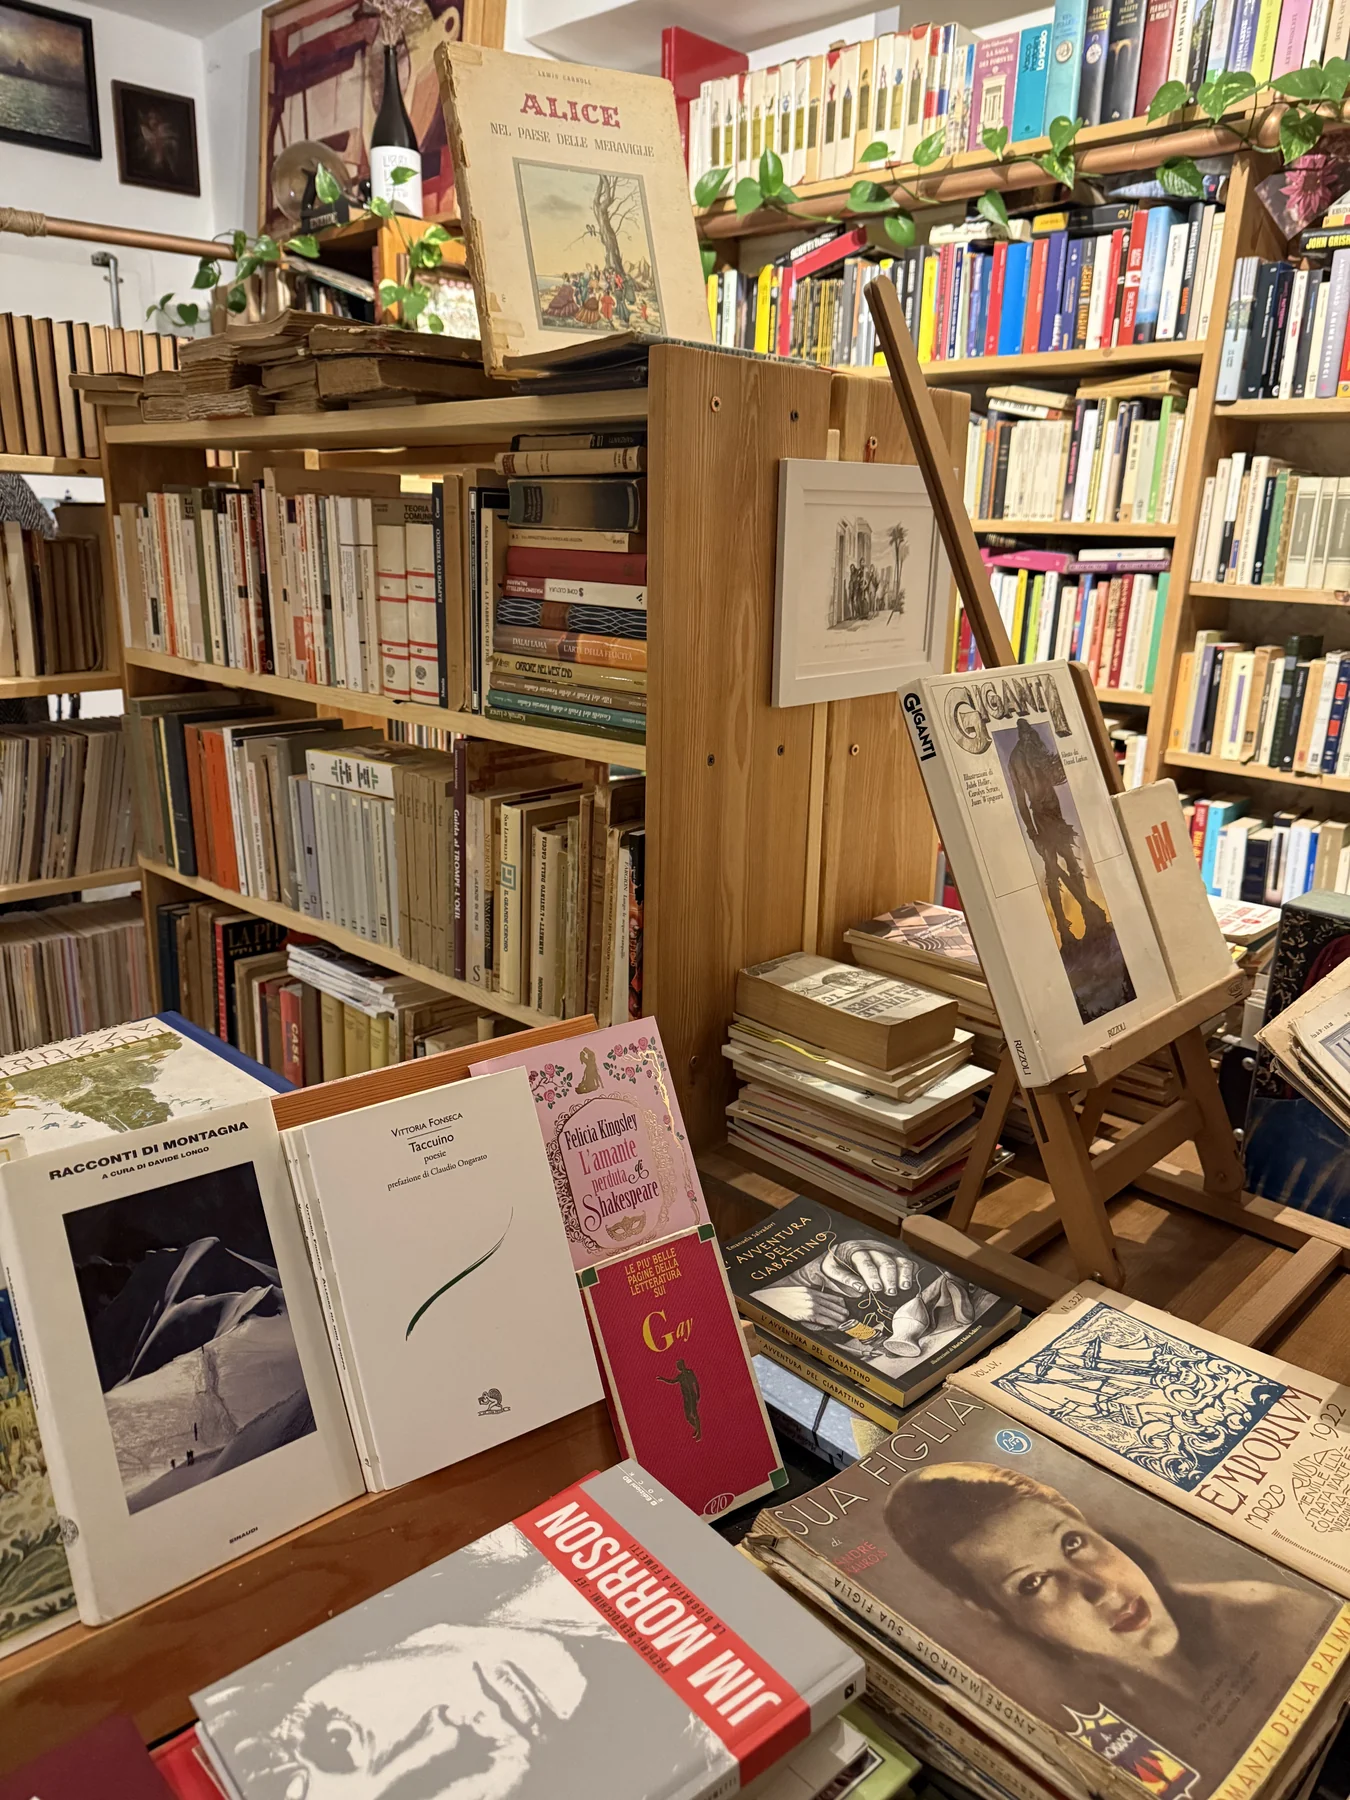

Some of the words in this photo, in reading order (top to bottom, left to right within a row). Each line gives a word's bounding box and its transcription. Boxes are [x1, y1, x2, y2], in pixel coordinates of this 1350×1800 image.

[520, 93, 621, 129] ALICE
[490, 122, 511, 138] NEL
[517, 126, 551, 143] PAESE
[557, 132, 588, 149] DELLE
[594, 138, 655, 158] MERAVIGLIE
[1305, 236, 1328, 250] JOHN
[1327, 312, 1338, 342] ANIME
[1321, 345, 1333, 379] FEROCI
[404, 504, 430, 512] TEORIA
[549, 586, 566, 594] CULTURA
[512, 637, 529, 647] DALAI
[529, 640, 547, 649] LAMA
[537, 663, 547, 674] NEL
[561, 666, 573, 678] END
[550, 705, 563, 713] della
[559, 688, 571, 698] della
[576, 691, 590, 701] Friuli
[591, 694, 600, 703] del
[602, 696, 613, 705] Ville
[568, 707, 582, 717] Friuli
[582, 709, 591, 718] del
[592, 710, 611, 721] Castelli
[904, 693, 937, 762] GIGANTI
[944, 674, 1073, 756] GIGANTI
[453, 838, 460, 848] al
[453, 849, 461, 920] TROMPE-L'OEIL
[291, 1023, 300, 1066] CASE
[1107, 1022, 1126, 1038] RIZZOLI
[1013, 1039, 1032, 1076] RIZZOLI
[391, 1121, 427, 1139] VITTORIA
[428, 1111, 464, 1130] FONSECA
[564, 1126, 598, 1152] Felicia
[599, 1112, 639, 1141] Kingsley
[49, 1150, 138, 1181] RACCONTI
[141, 1143, 160, 1157] DI
[162, 1121, 250, 1150] MONTAGNA
[408, 1132, 456, 1154] Taccuino
[423, 1150, 448, 1165] poesie
[579, 1137, 639, 1176] L'amante
[101, 1172, 109, 1180] A
[110, 1165, 136, 1178] CURA
[137, 1162, 147, 1171] DI
[147, 1154, 180, 1169] DAVIDE
[180, 1146, 211, 1162] LONGO
[386, 1171, 421, 1192] prefazione
[421, 1168, 430, 1179] di
[430, 1162, 456, 1177] Claudio
[457, 1153, 489, 1173] Ongarato
[591, 1169, 628, 1197] perduta
[628, 1160, 650, 1185] di
[582, 1179, 660, 1233] Shakespeare
[726, 1233, 751, 1251] Emanuela
[751, 1221, 776, 1239] Salvadori
[735, 1215, 812, 1265] AVVENTURA
[764, 1242, 793, 1262] DEL
[624, 1263, 636, 1275] LE
[652, 1247, 677, 1264] BELLE
[627, 1268, 654, 1286] PAGINE
[655, 1259, 680, 1275] DELLA
[750, 1231, 829, 1282] CIABATTINO
[631, 1268, 682, 1296] LETTERATURA
[654, 1286, 667, 1298] SUI
[6, 1266, 22, 1327] RACCONTI
[19, 1329, 24, 1337] DI
[1068, 1292, 1084, 1306] 327
[643, 1309, 694, 1353] Gay
[760, 1314, 768, 1323] L'
[767, 1316, 808, 1348] AVVENTURA
[811, 1344, 824, 1357] DEL
[828, 1352, 871, 1384] CIABATTINO
[762, 1342, 803, 1372] AVVENTURA
[805, 1366, 818, 1380] DEL
[822, 1379, 866, 1410] CIABATTINO
[773, 1486, 870, 1537] SUA
[858, 1396, 984, 1486] FIGLIA
[1196, 1384, 1323, 1517] EMPORIVM
[1243, 1484, 1286, 1530] MARZO
[1309, 1403, 1347, 1442] 1922
[229, 1526, 259, 1544] EINAUDI
[830, 1534, 843, 1548] di
[629, 1543, 663, 1575] FUMETTI
[533, 1501, 718, 1668] MORRISON
[573, 1577, 591, 1589] JEF
[661, 1574, 670, 1582] A
[669, 1581, 714, 1624] BIOGRAFIA
[833, 1576, 873, 1616] FIGLIA
[591, 1592, 637, 1639] BERTOCCHINI
[712, 1622, 727, 1635] LA
[878, 1611, 905, 1637] SUA
[915, 1640, 982, 1693] MAUROIS
[686, 1649, 783, 1728] JIM
[984, 1692, 1037, 1735] ANDRÉ
[1271, 1680, 1320, 1738] DELLA
